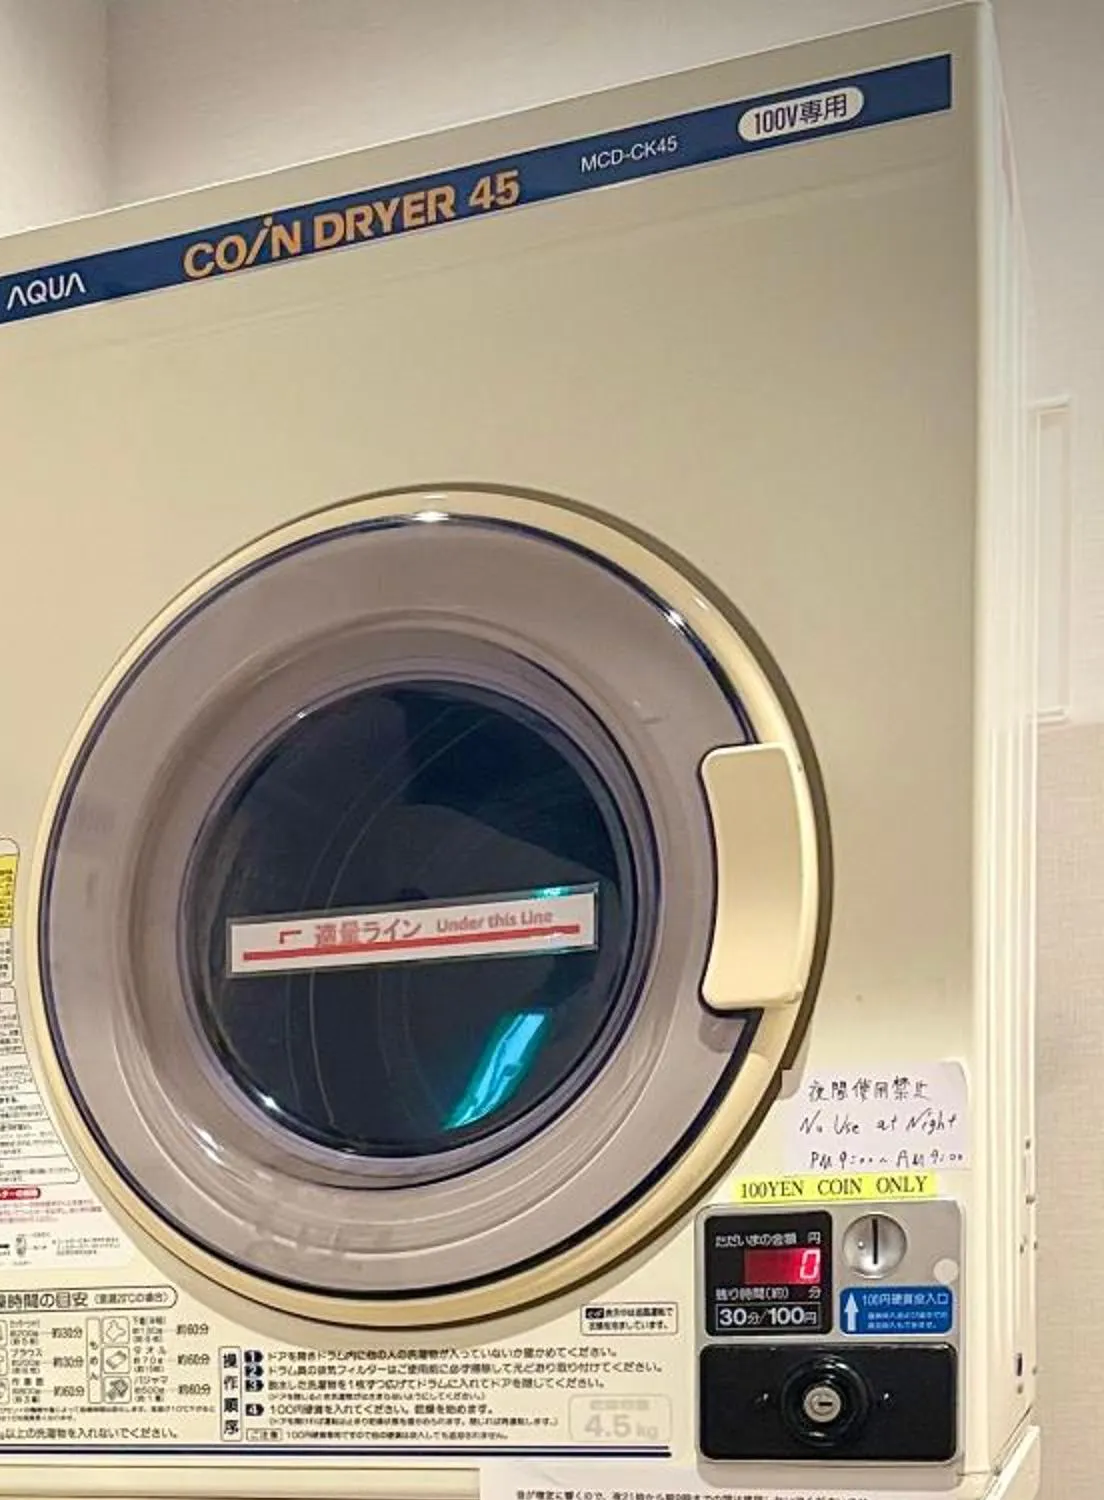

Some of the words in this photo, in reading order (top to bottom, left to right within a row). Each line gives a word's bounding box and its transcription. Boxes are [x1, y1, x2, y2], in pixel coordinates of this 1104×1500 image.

[754, 93, 847, 135] 100V専用
[580, 135, 678, 173] MCD-CK45
[312, 189, 456, 252] DRYER
[467, 169, 521, 213] 45
[7, 272, 86, 311] AQUA
[314, 919, 422, 947] 適量ライン
[437, 915, 484, 933] Under
[487, 912, 518, 930] this
[521, 908, 554, 926] Line
[808, 1076, 932, 1102] 夜間使用禁止
[799, 1110, 822, 1134] No
[834, 1118, 861, 1135] Use
[876, 1116, 898, 1132] at
[905, 1108, 958, 1136] Night
[740, 1180, 805, 1198] 100YEN
[817, 1177, 864, 1196] COIN
[876, 1175, 928, 1194] ONLY
[719, 1306, 816, 1326] 30分/100円
[584, 1414, 631, 1438] 4.5
